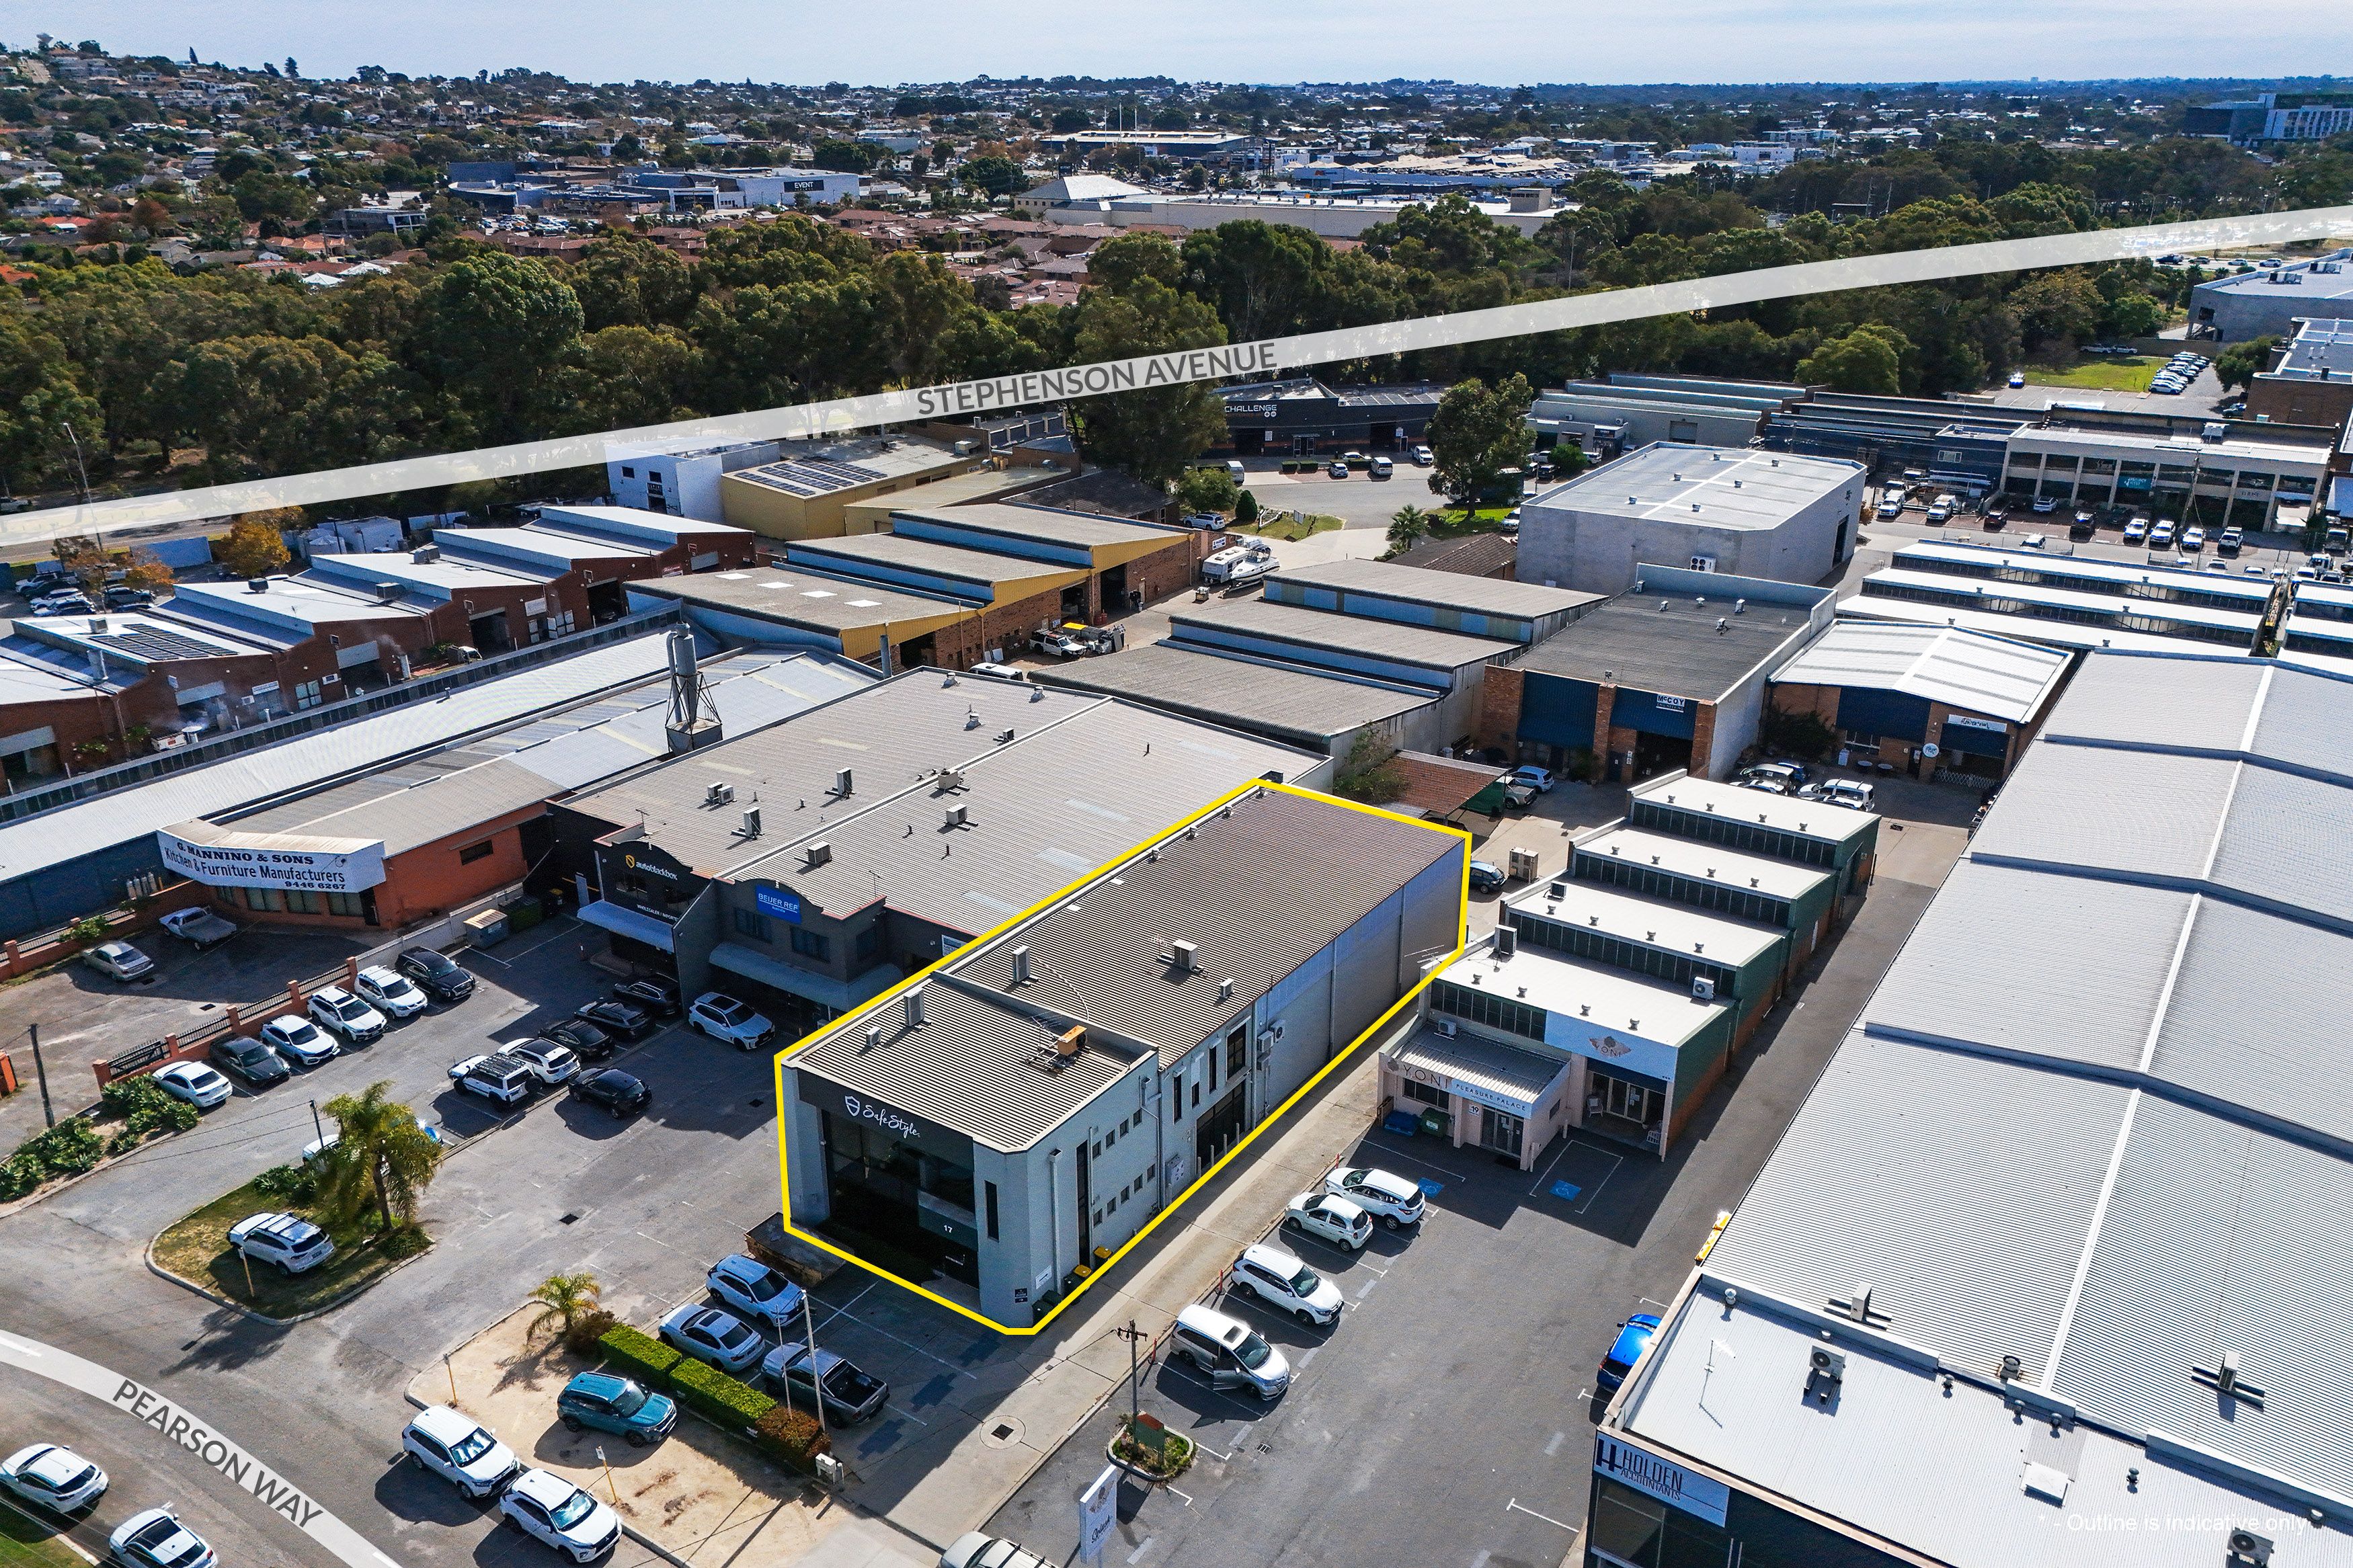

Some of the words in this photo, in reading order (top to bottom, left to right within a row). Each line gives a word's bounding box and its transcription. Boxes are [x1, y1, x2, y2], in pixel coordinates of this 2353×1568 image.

[165, 847, 193, 869] Kitchen
[194, 858, 200, 872] &
[201, 861, 256, 878] Furniture
[259, 865, 345, 882] Manufacturers
[177, 842, 186, 852] G.
[187, 845, 252, 861] MANNINO
[257, 854, 268, 862] &
[272, 854, 314, 864] SONS
[636, 861, 678, 880] autoblackbox
[758, 893, 782, 907] BEIJER
[784, 901, 798, 911] REF
[1594, 1044, 1621, 1057] YONI
[1403, 1064, 1448, 1089] YONI
[1455, 1083, 1494, 1100] PLEASURE
[1497, 1097, 1526, 1111] PALACE
[943, 1225, 953, 1233] 17
[1622, 1449, 1683, 1491] HOLDEN
[1621, 1469, 1681, 1501] ACCOUNTANTS
